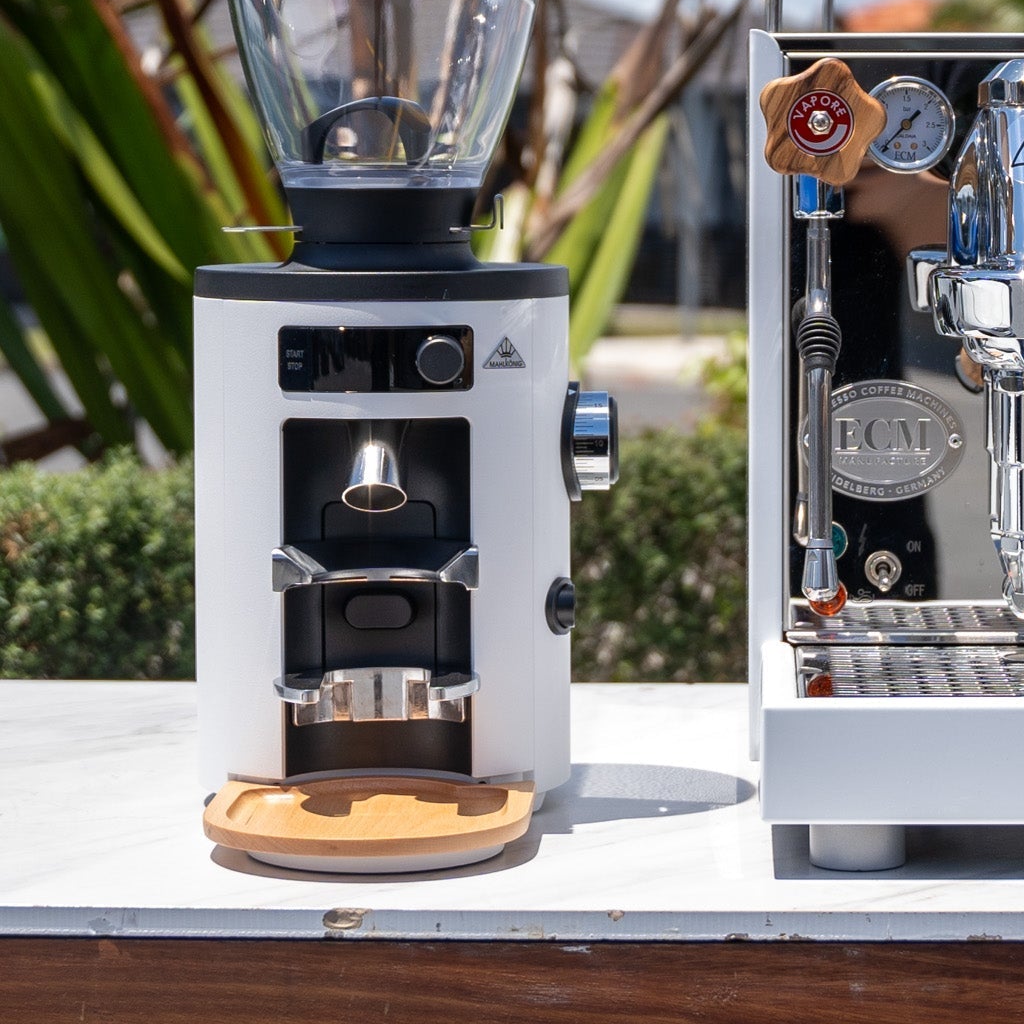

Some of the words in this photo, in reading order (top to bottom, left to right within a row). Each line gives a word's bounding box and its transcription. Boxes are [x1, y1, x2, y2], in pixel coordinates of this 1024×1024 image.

[793, 96, 847, 119] VAPORE
[894, 151, 916, 161] ECM
[286, 349, 304, 358] START
[288, 362, 302, 370] STOP
[861, 386, 903, 396] COFFEE
[906, 390, 957, 429] MACHINES
[835, 418, 931, 451] ECM
[594, 439, 604, 447] 10
[839, 456, 927, 465] MANUFACTURE
[831, 473, 885, 496] IDELBERG
[895, 466, 946, 494] GERMANY
[907, 540, 921, 553] ON
[906, 583, 925, 596] OFF
